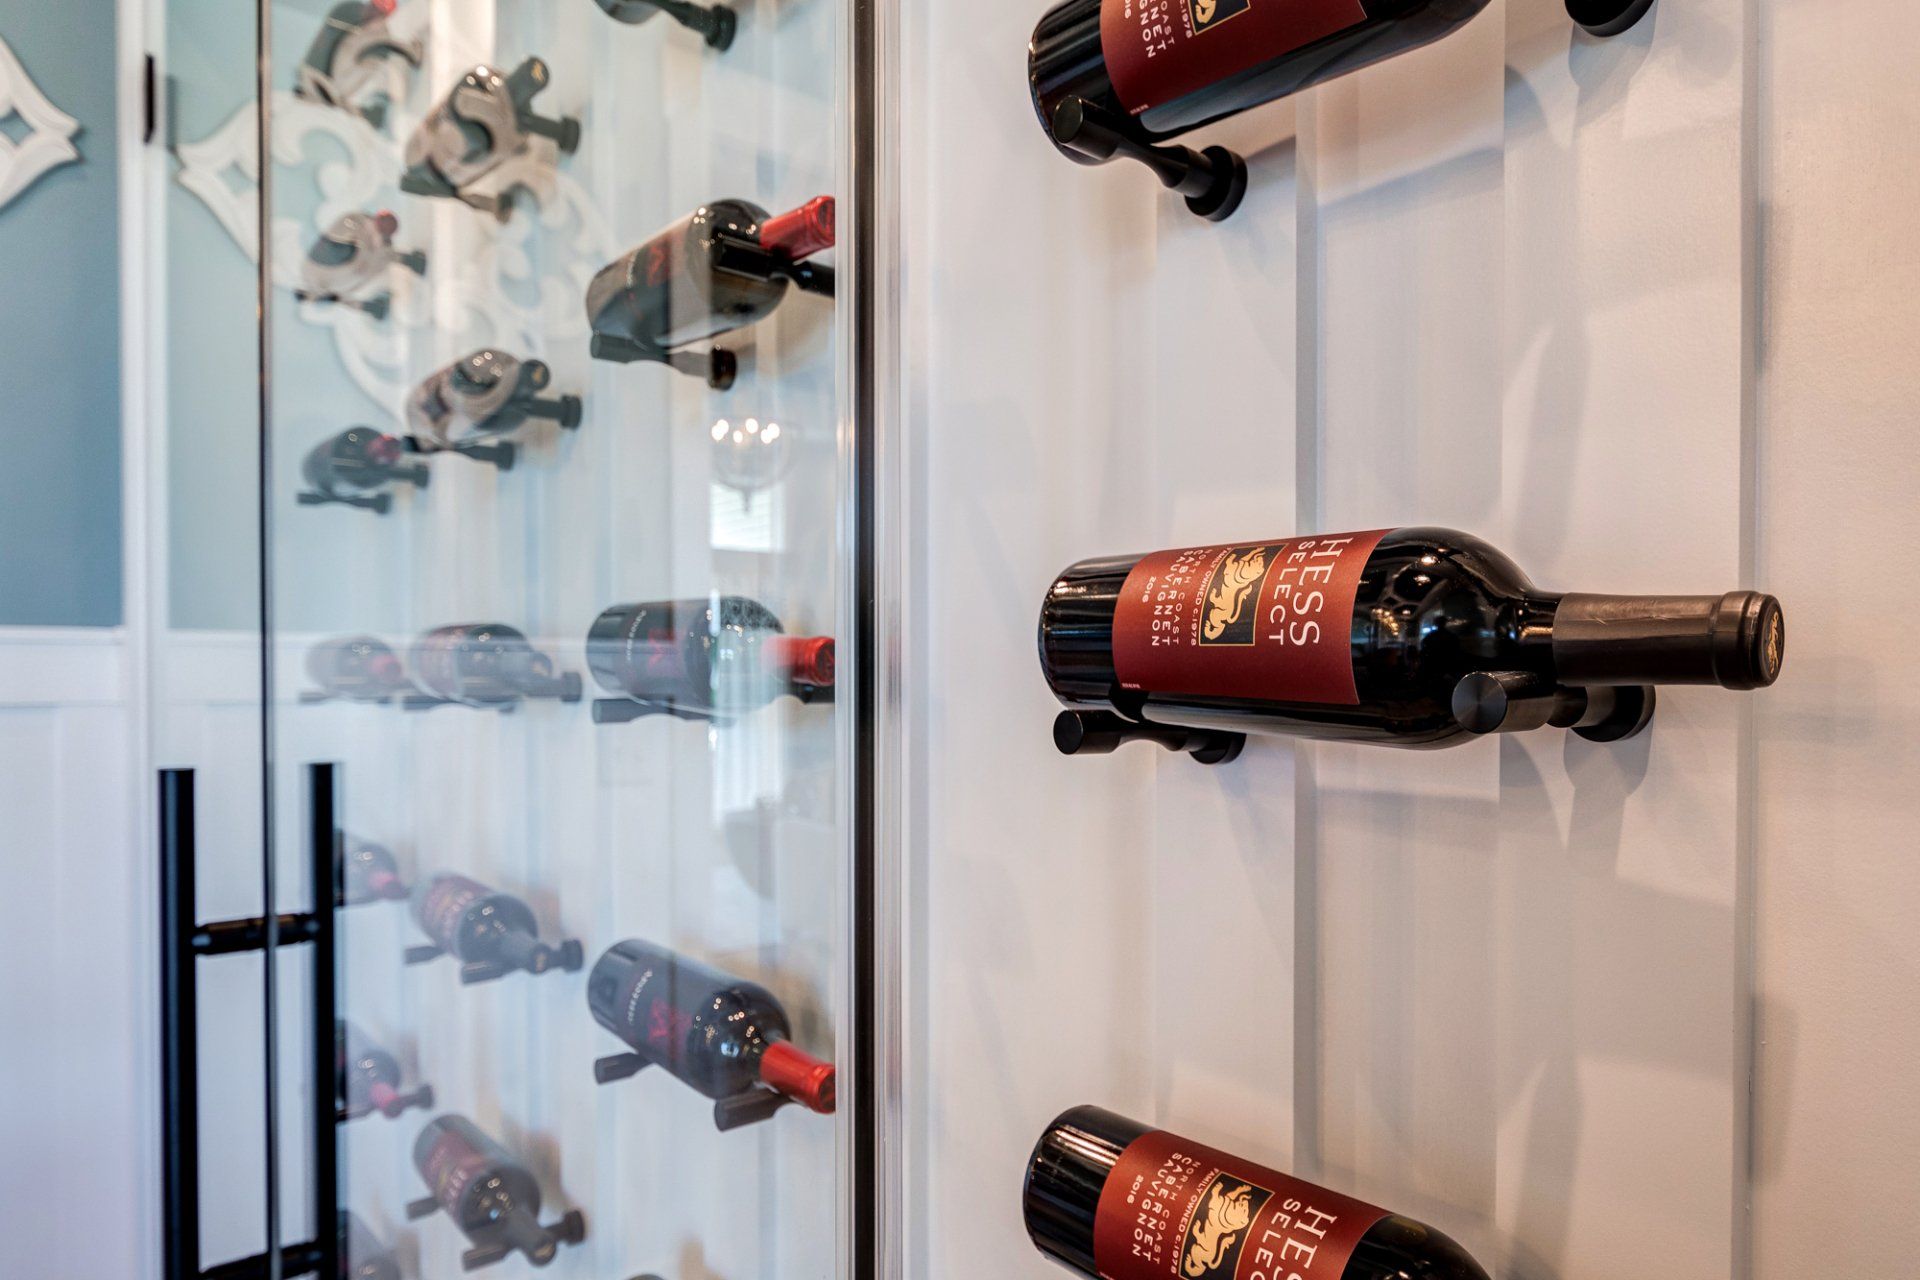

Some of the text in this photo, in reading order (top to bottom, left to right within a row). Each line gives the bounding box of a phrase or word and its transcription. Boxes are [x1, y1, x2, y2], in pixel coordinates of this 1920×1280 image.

[1149, 0, 1167, 51] NET
[1141, 576, 1156, 603] 2016
[1151, 550, 1195, 646] SAUVIGNON
[1162, 549, 1204, 646] CABERNET
[1172, 593, 1186, 645] COAST
[1195, 570, 1214, 606] OWNED
[1269, 540, 1310, 646] SELECT
[1290, 536, 1353, 647] HESS
[1126, 1175, 1144, 1204] 2016
[1131, 1151, 1182, 1257] SAUVIGNON
[1141, 1156, 1192, 1263] CABERNET
[1152, 1160, 1202, 1265] NORTH COAST
[1178, 1194, 1199, 1238] OWNED
[1197, 1168, 1220, 1194] FAMILY
